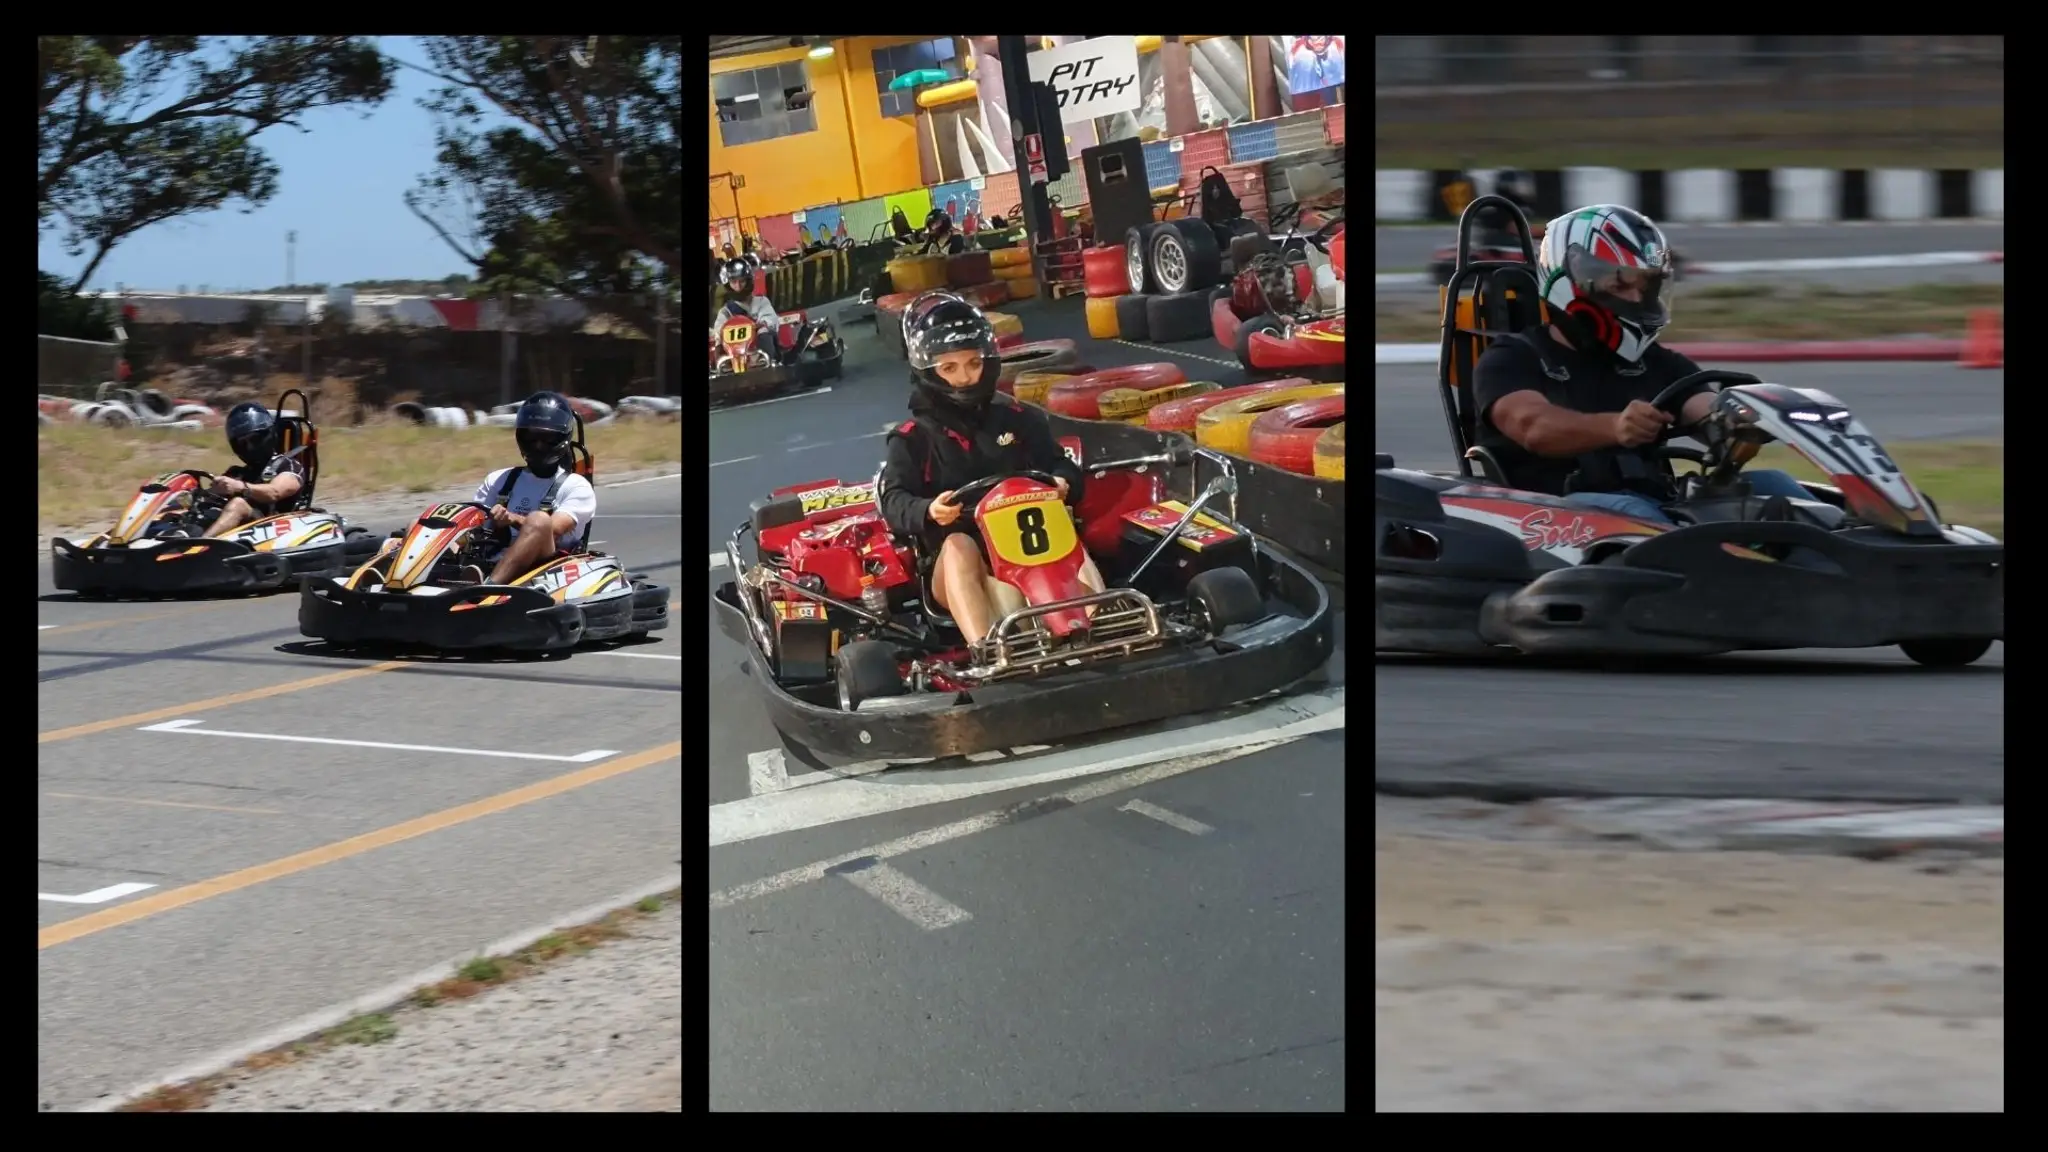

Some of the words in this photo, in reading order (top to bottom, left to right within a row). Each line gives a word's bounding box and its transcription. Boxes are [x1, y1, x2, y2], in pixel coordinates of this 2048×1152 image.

[1048, 56, 1104, 86] PIT
[1056, 74, 1135, 108] NTRY
[729, 327, 747, 341] 18
[1016, 507, 1050, 556] 8
[1520, 509, 1597, 552] Sodi
